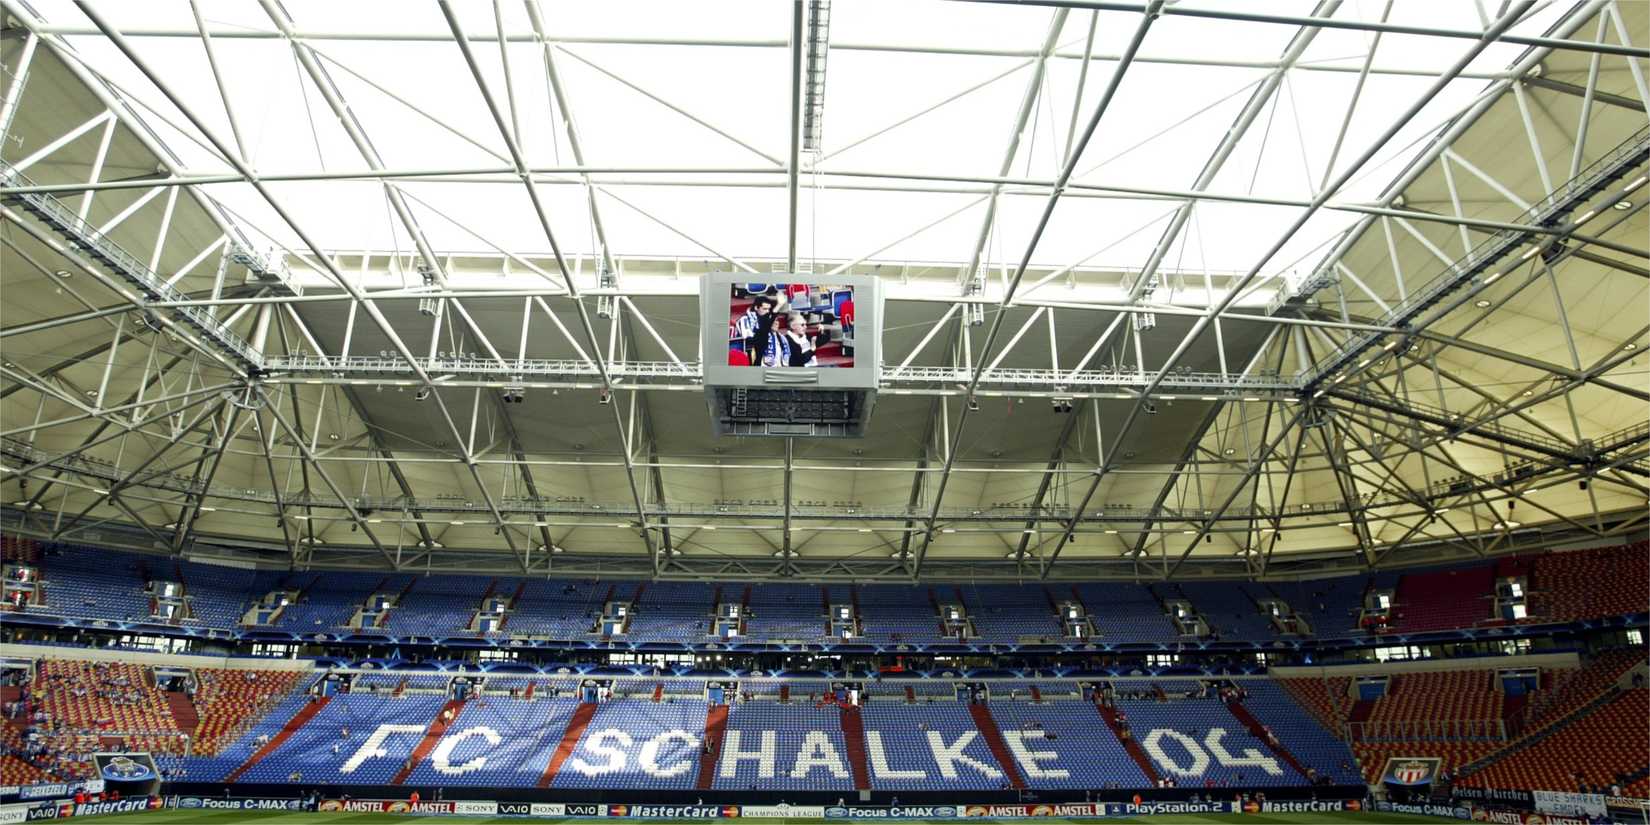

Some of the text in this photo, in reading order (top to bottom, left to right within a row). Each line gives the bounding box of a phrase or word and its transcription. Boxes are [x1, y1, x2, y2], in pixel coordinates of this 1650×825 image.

[339, 724, 1284, 778] FC SCHALKE 04
[75, 800, 148, 816] MasterCard
[202, 799, 240, 809] Focus
[244, 799, 287, 810] C-MAX
[343, 802, 384, 812] AMSTEL
[410, 802, 453, 813] AMSTEL
[501, 805, 528, 814] VAIO
[568, 806, 596, 814] VAIO
[1262, 801, 1342, 813] MasterCard
[1392, 802, 1422, 813] Focus
[1424, 804, 1454, 817] C-MAX
[29, 808, 55, 819] VAIO
[630, 805, 718, 817] MasterCard
[849, 807, 887, 817] Focus
[891, 807, 934, 817] C-MAX
[988, 806, 1028, 817] AMSTEL
[1054, 805, 1094, 816] AMSTEL
[1487, 810, 1523, 825] AMSTEL
